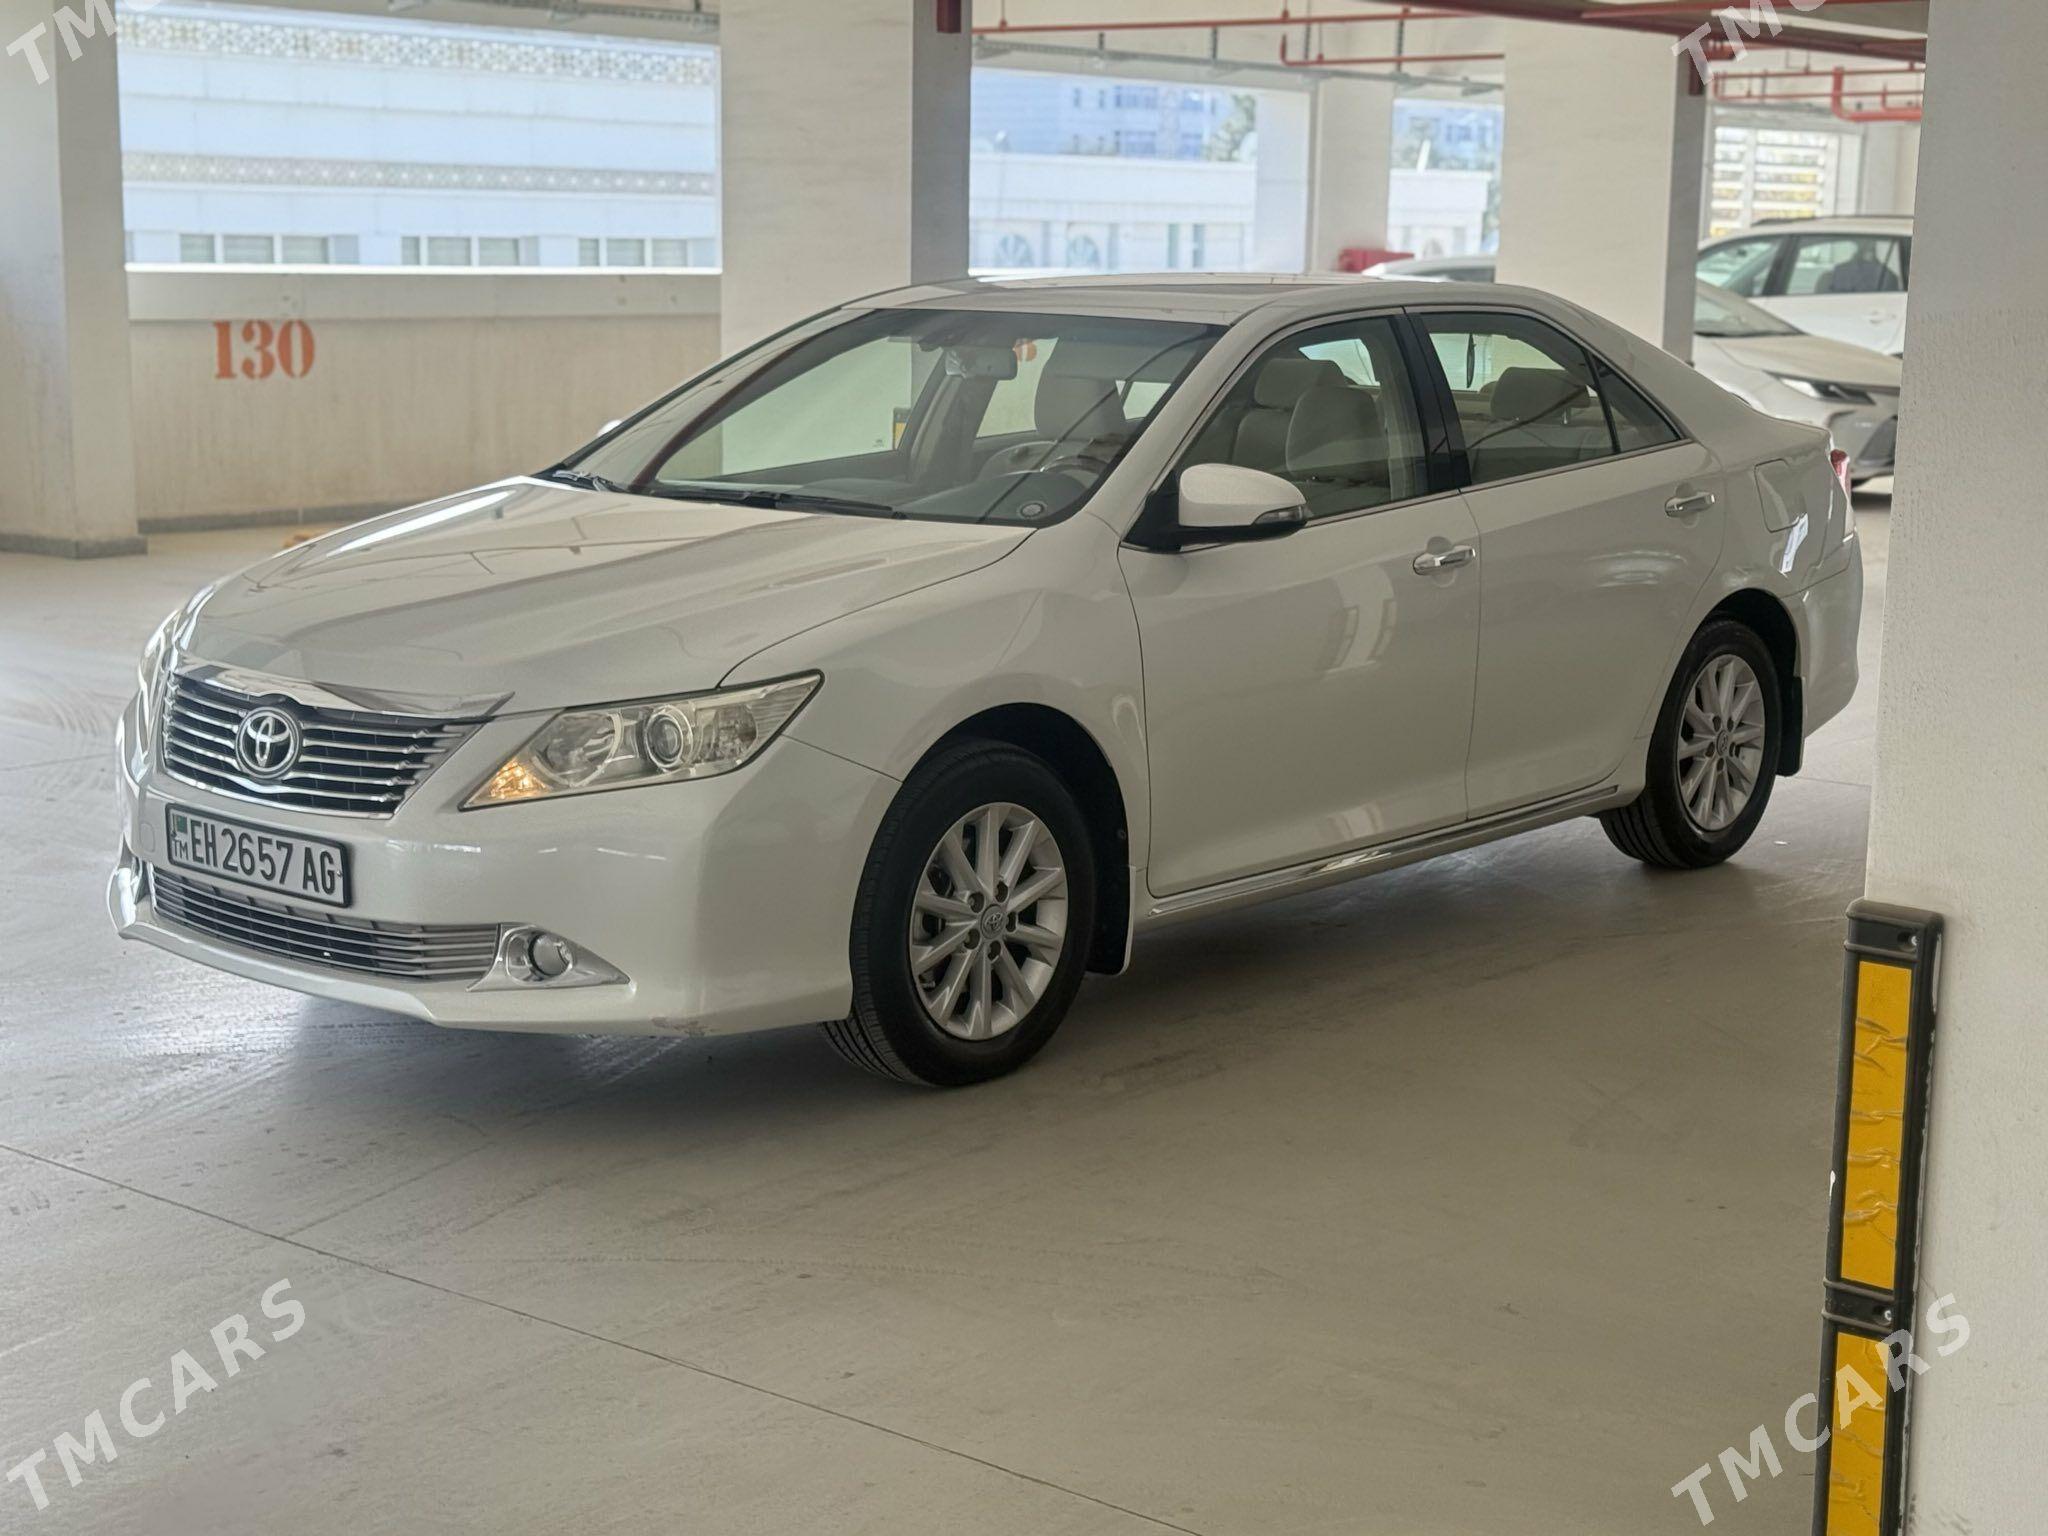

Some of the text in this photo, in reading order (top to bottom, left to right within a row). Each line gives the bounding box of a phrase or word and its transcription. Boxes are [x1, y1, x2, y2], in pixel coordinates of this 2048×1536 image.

[213, 319, 315, 379] 130
[173, 838, 189, 860] TM
[302, 846, 336, 895] AG
